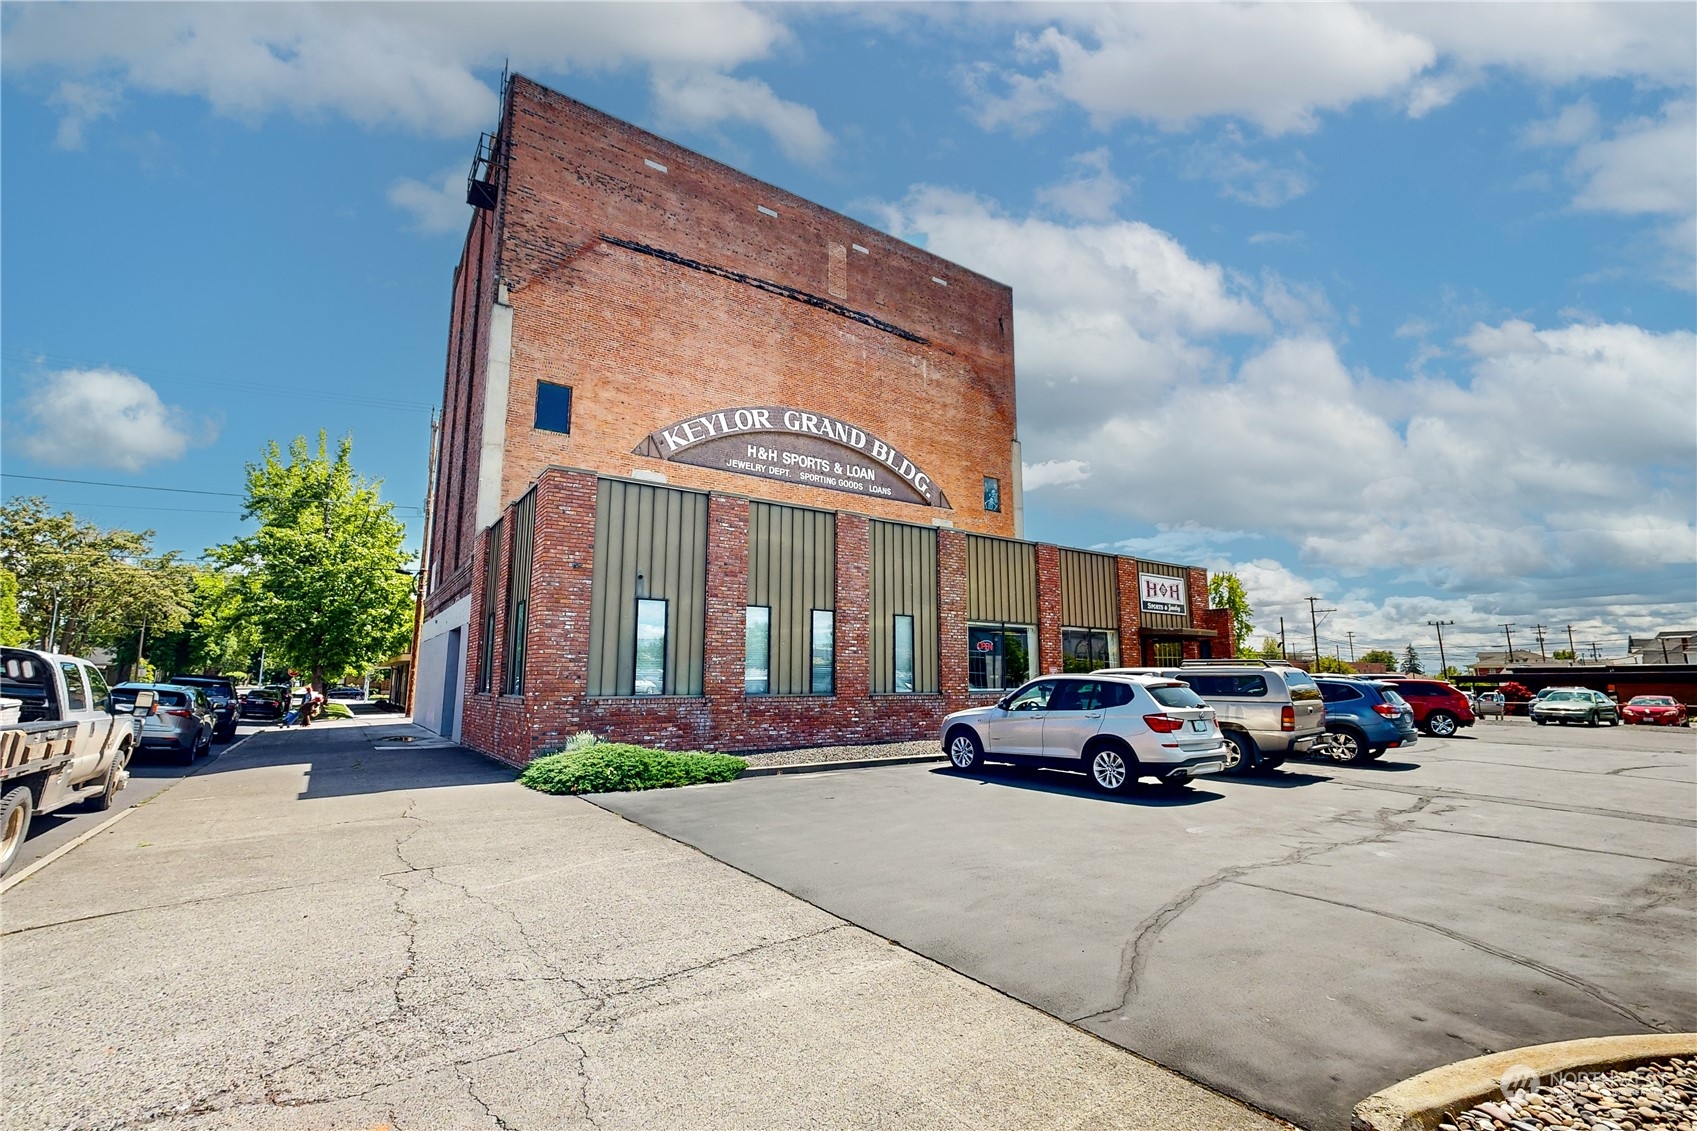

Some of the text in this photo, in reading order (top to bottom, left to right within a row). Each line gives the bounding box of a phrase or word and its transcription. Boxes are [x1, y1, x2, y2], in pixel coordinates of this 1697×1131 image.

[662, 409, 932, 498] KEYLOR GRAND BLDG.
[747, 444, 875, 480] H&H SPORTS & LOAN
[726, 459, 892, 496] JEWELRY DEPT. SPORTING GOODS LOANS
